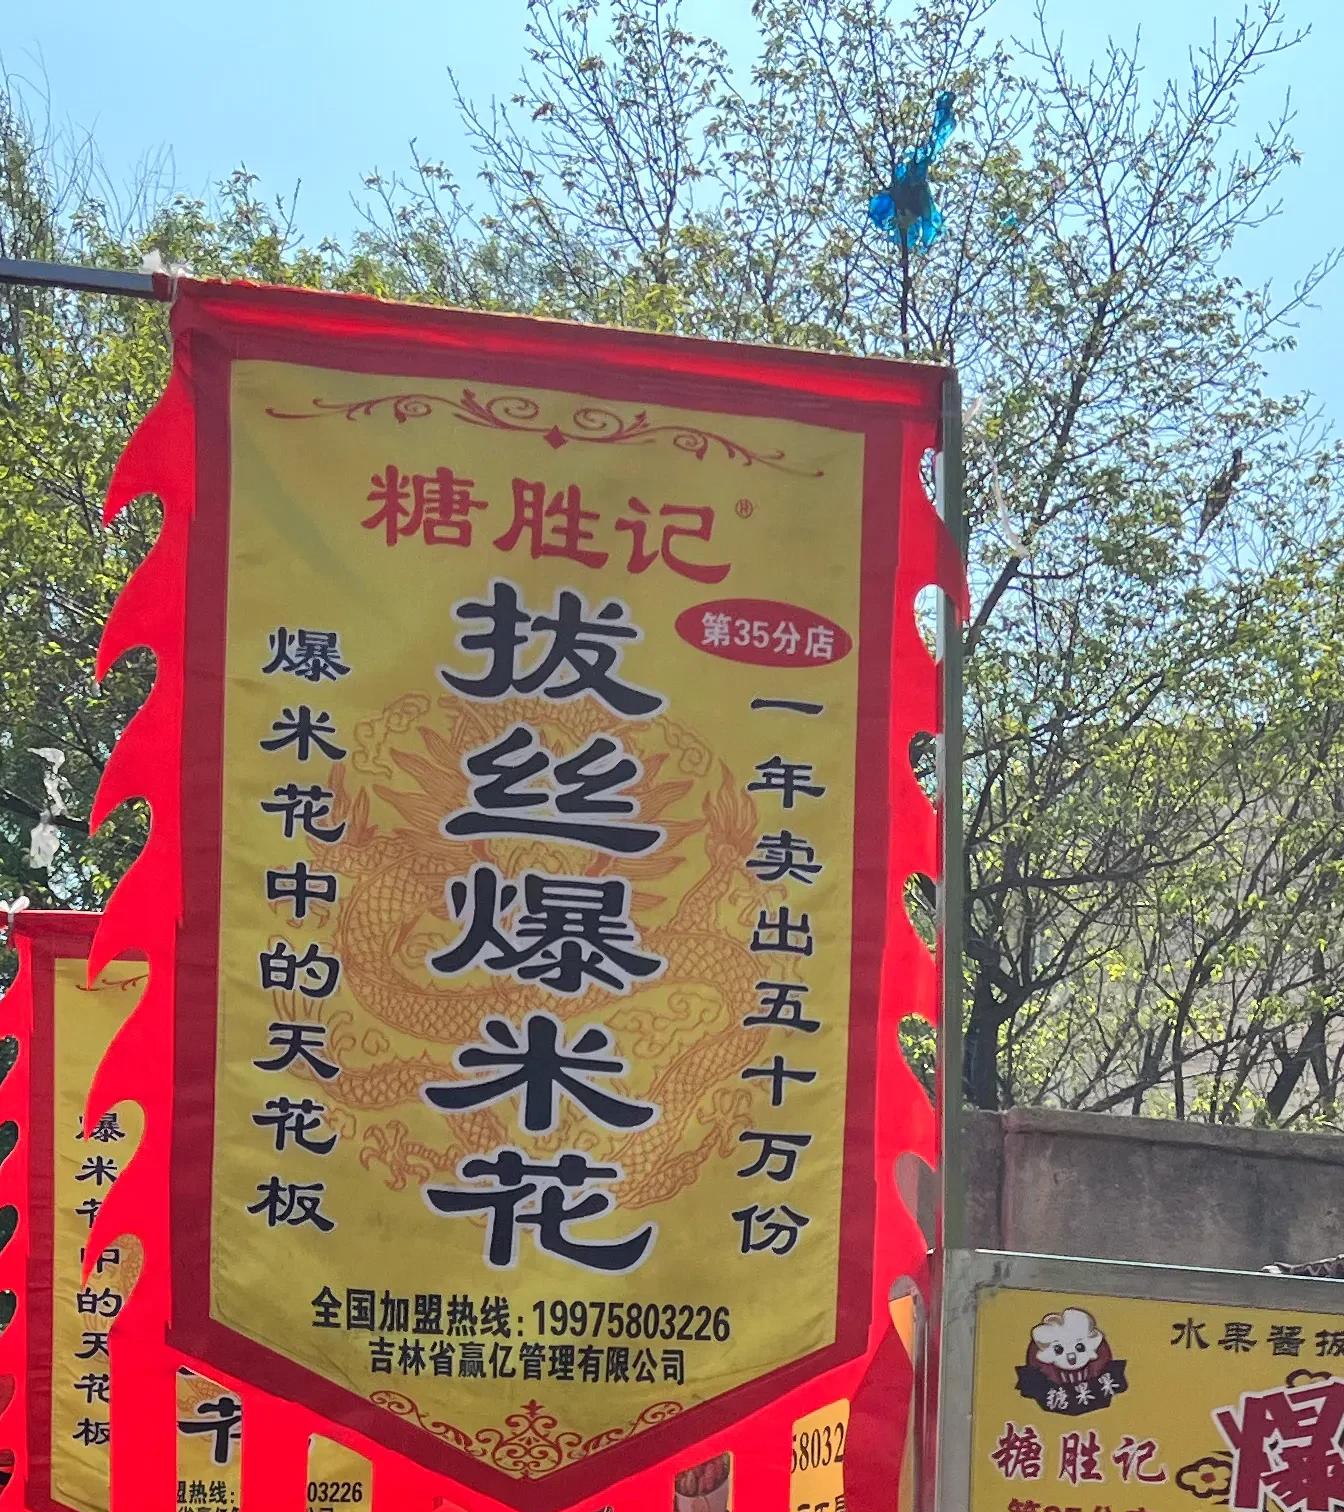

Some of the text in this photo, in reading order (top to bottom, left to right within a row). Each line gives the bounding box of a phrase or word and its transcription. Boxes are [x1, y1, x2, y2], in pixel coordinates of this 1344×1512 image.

[360, 463, 731, 585] 糖胜记
[700, 611, 835, 662] 第35分店
[246, 625, 351, 1233] 爆米花中的天花板
[424, 581, 666, 1271] 拔丝爆米花
[731, 696, 826, 1256] 一年卖出五十万份
[367, 1335, 686, 1387] 吉林省赢亿管理有限公司
[991, 1421, 1168, 1486] 糖胜记
